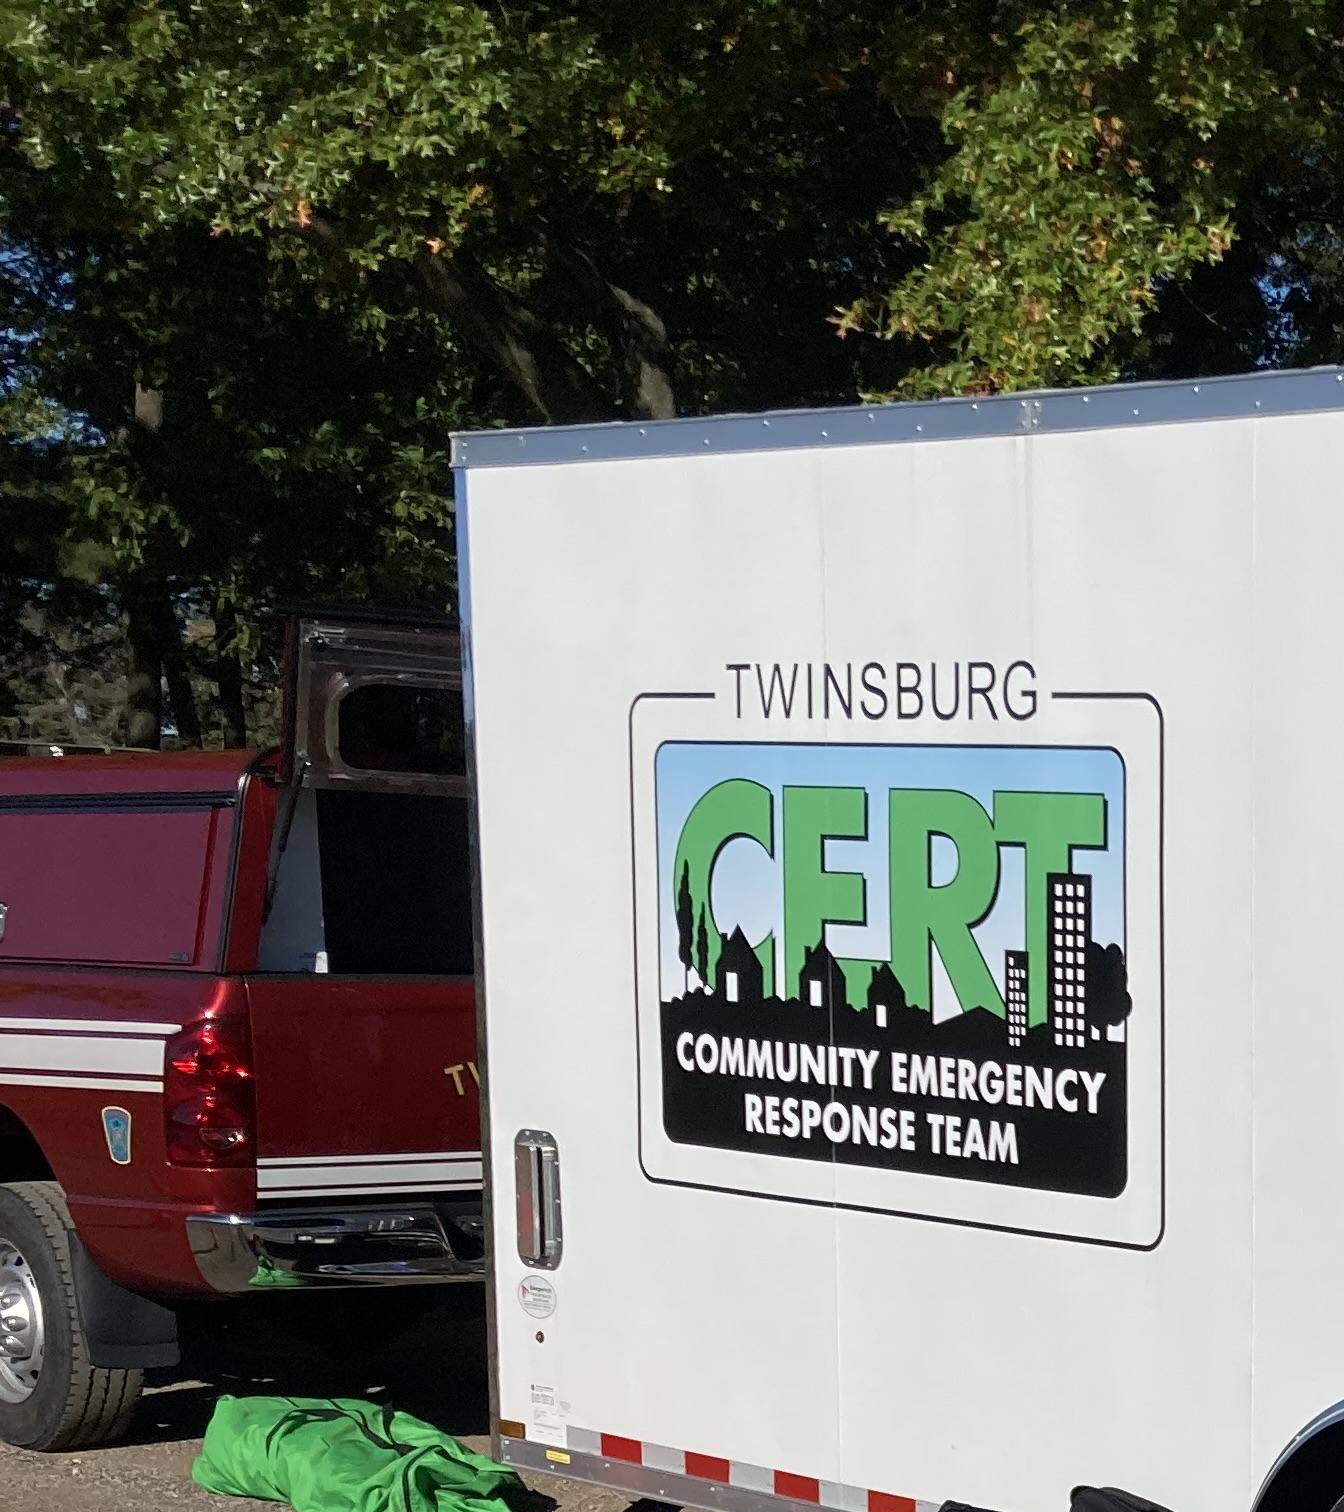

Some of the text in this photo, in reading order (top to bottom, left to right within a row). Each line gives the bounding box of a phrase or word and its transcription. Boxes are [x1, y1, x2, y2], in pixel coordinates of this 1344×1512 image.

[725, 660, 1039, 722] TWINSBURG
[673, 777, 1109, 1030] CERT
[675, 1031, 1107, 1114] COMMUNITY EMERGENCY
[744, 1093, 1020, 1165] RESPONSE TEAM
